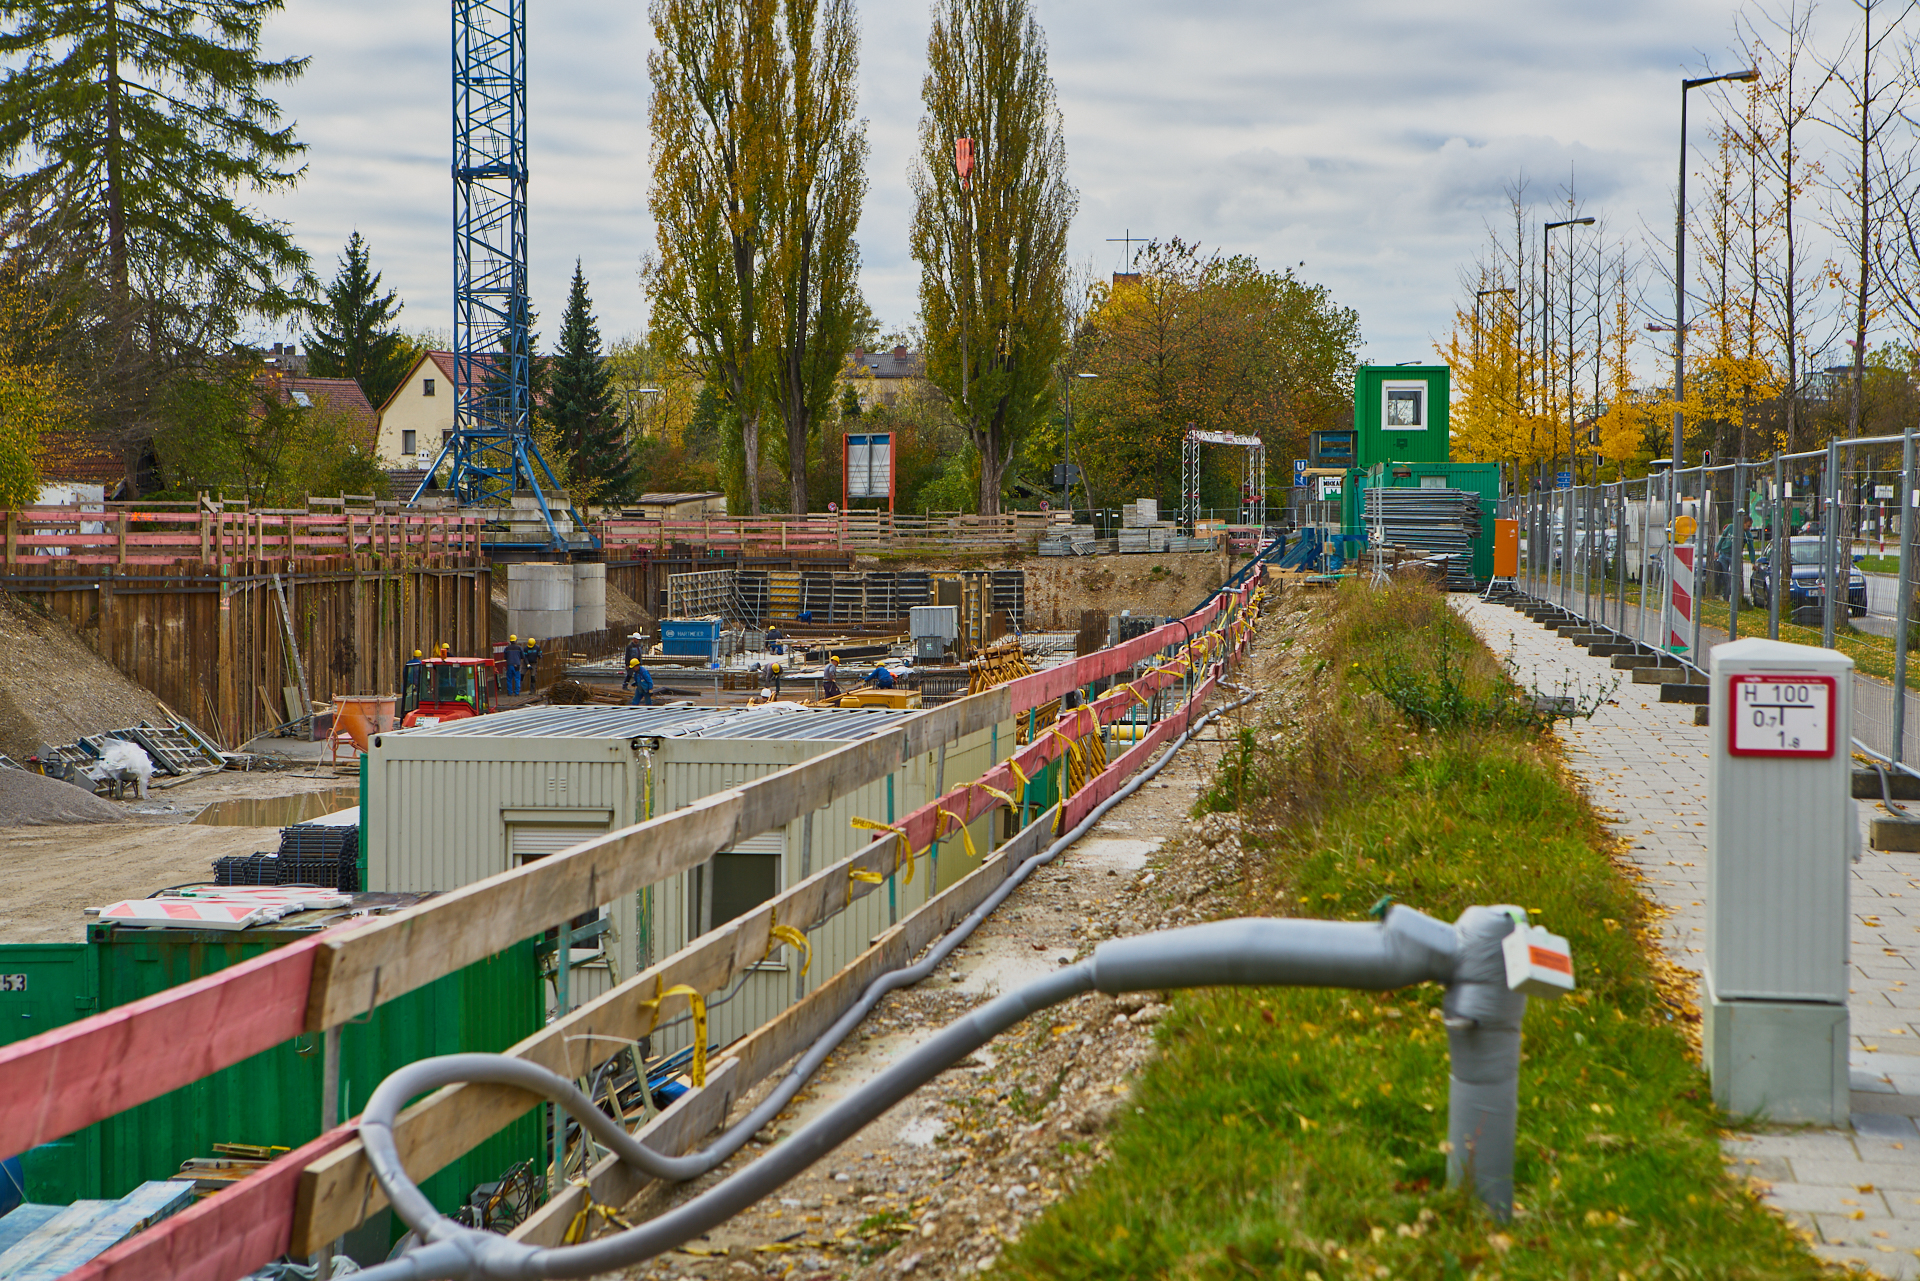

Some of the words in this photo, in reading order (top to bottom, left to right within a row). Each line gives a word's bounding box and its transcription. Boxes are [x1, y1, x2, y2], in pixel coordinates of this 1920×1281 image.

[1297, 461, 1304, 471] U
[1744, 684, 1757, 702] H
[1772, 685, 1809, 703] 100
[3, 974, 26, 991] 53
